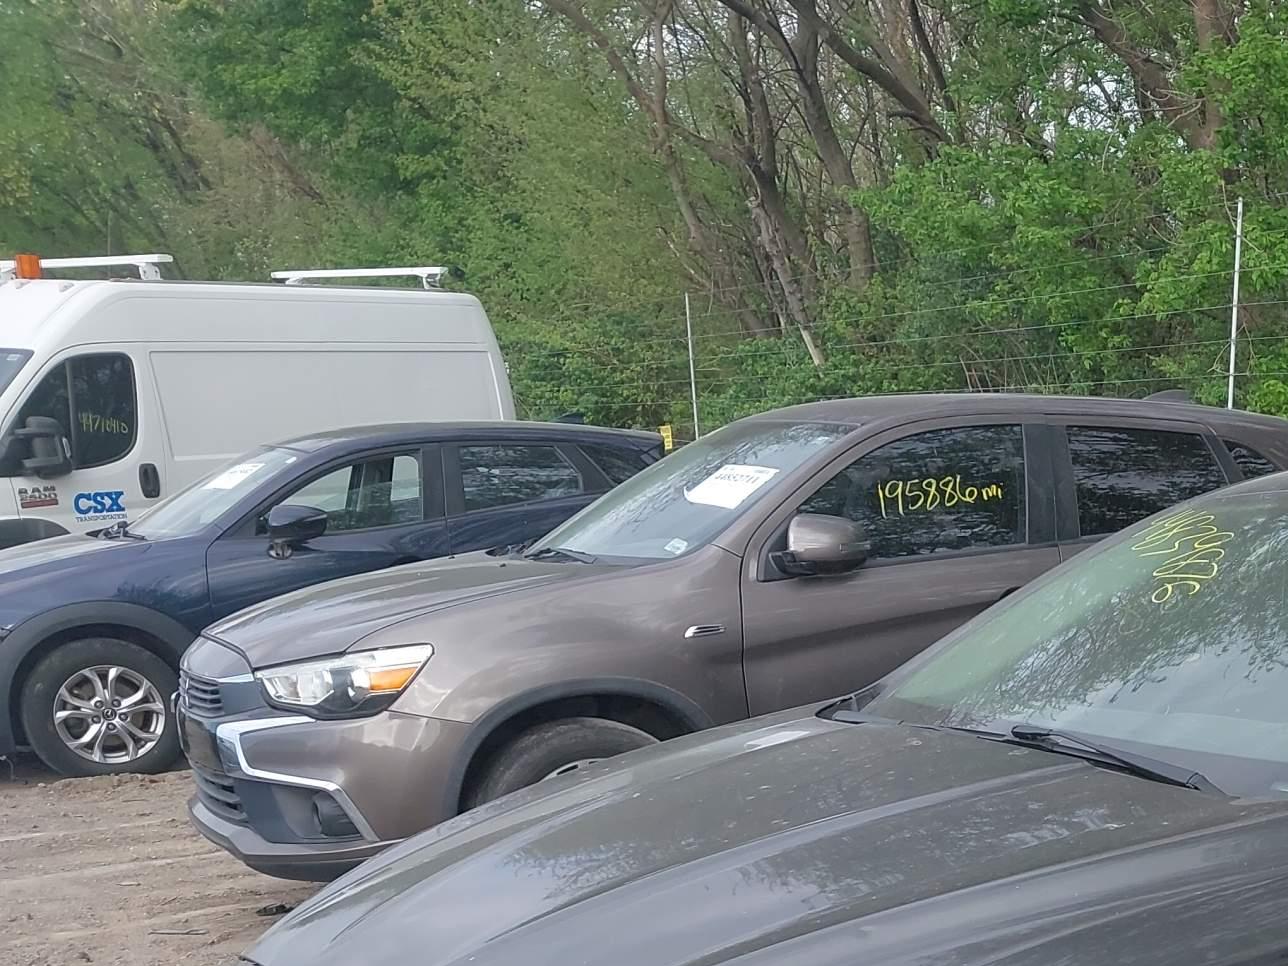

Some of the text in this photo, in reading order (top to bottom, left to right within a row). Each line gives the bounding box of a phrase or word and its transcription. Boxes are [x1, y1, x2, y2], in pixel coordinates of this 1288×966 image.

[18, 485, 56, 495] RAM
[73, 490, 126, 515] CSX
[75, 513, 128, 523] TRANSPORTATION
